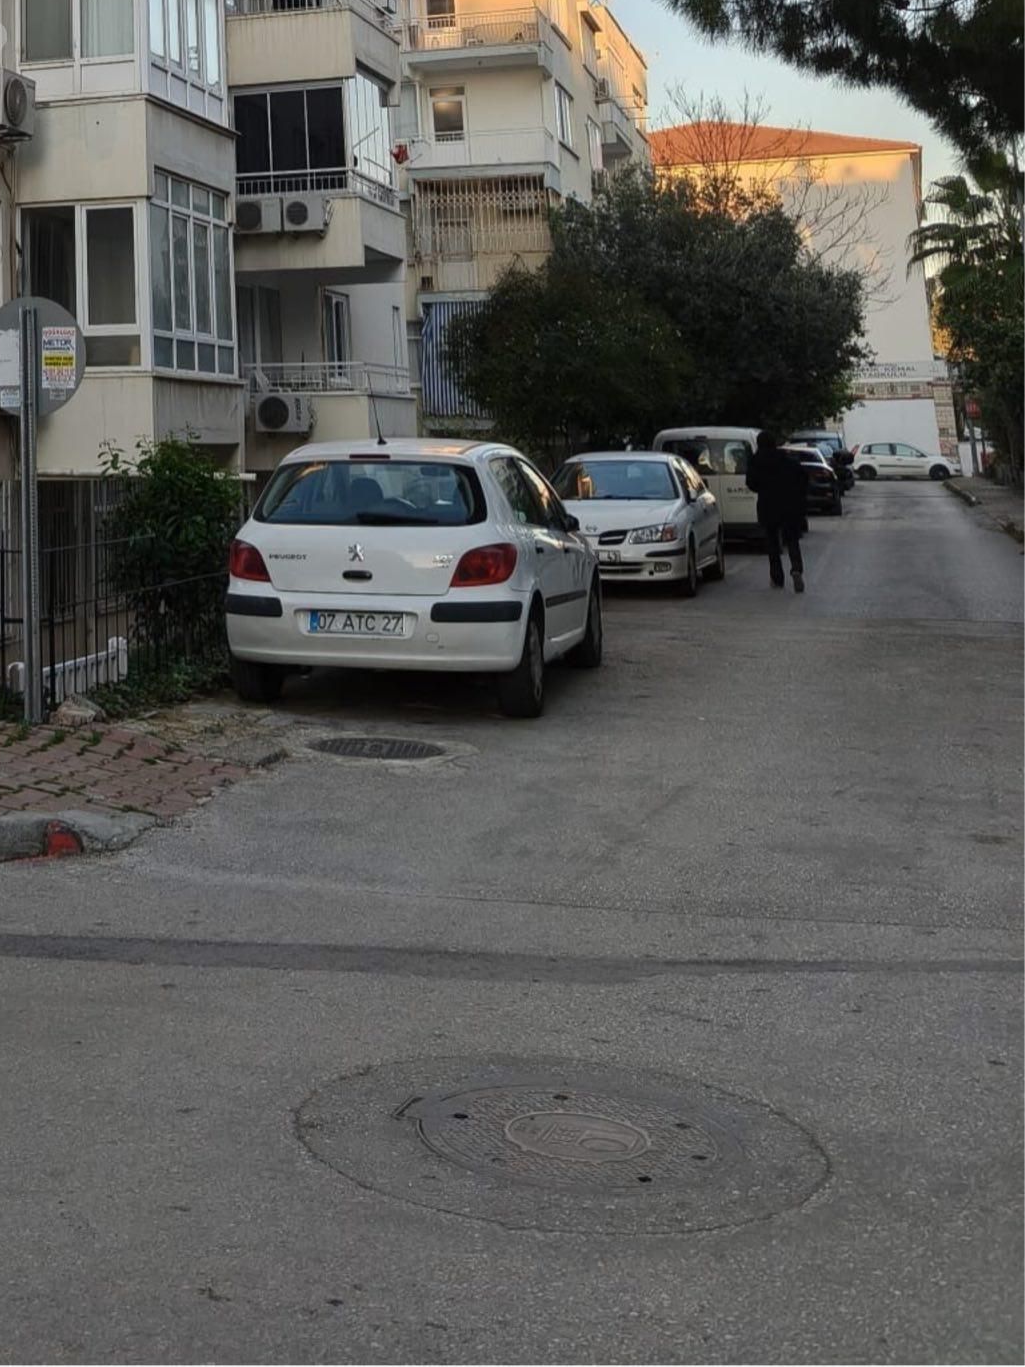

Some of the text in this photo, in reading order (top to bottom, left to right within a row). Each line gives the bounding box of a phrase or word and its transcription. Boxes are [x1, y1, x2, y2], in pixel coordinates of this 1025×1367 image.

[318, 615, 401, 631] 07 ATC 27
